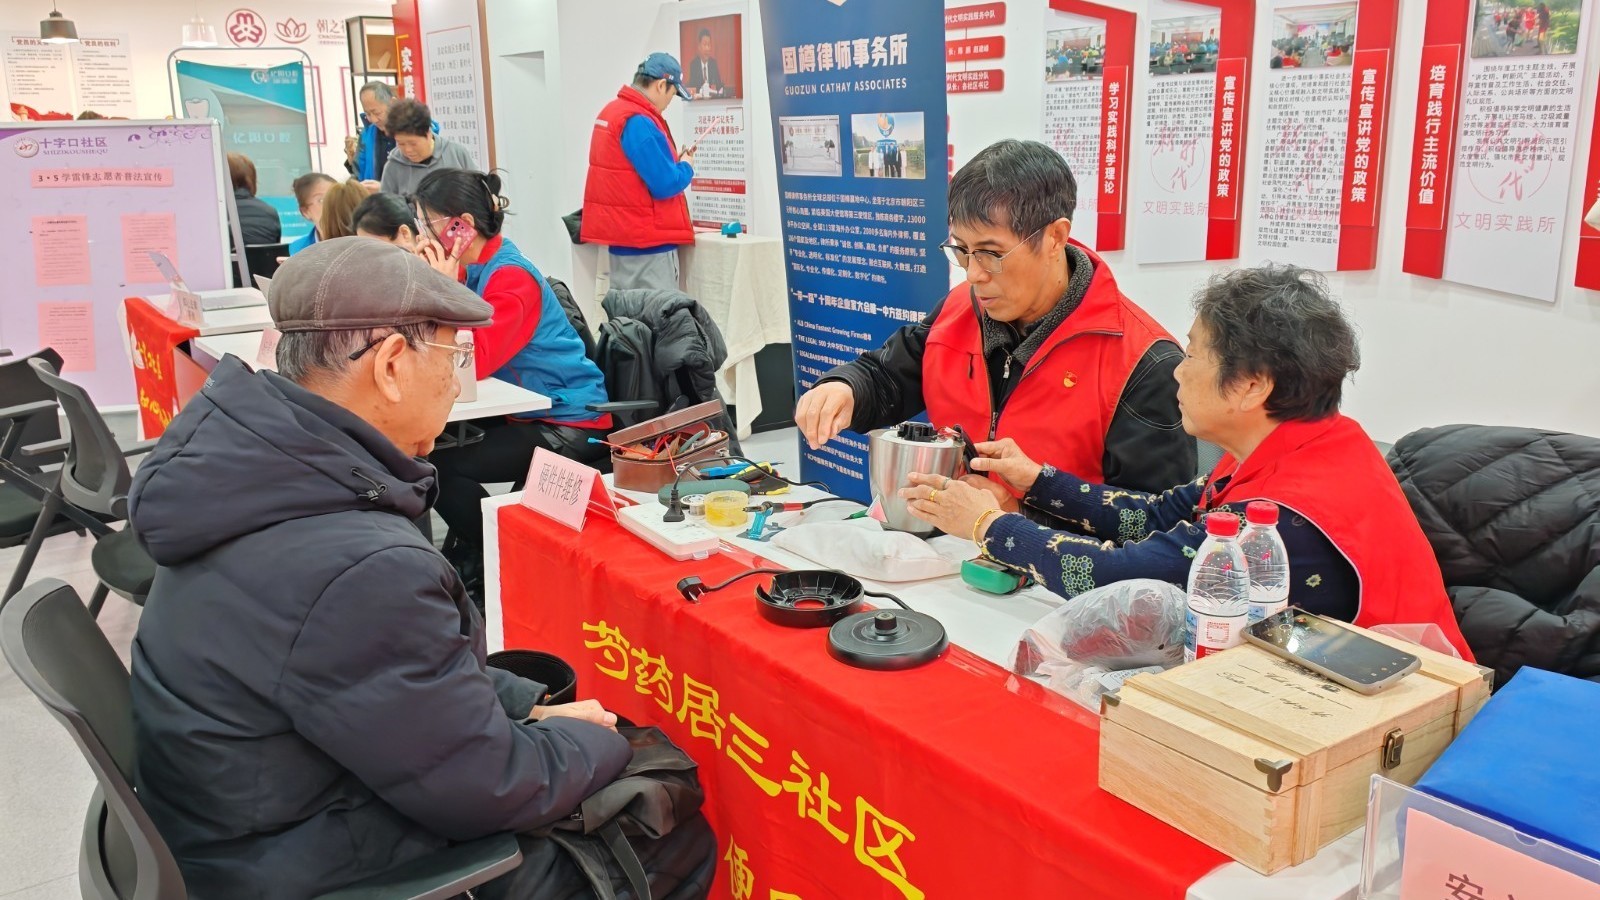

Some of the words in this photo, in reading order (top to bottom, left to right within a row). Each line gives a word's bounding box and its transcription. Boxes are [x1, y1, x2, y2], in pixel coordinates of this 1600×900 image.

[781, 33, 908, 74] 国樽律师事务所
[785, 84, 817, 95] GUOZUN
[820, 82, 851, 93] CATHAY
[854, 78, 907, 91] ASSOCIATES
[39, 137, 108, 148] 十字口社区
[1104, 82, 1120, 195] 学习实践科学理论
[1216, 75, 1237, 198] 宣传宣讲党的政策
[1351, 68, 1377, 203] 宣传宣讲党的政策
[1418, 65, 1447, 205] 培育践行主流价值
[1143, 201, 1209, 216] 文明实践所
[1454, 211, 1557, 234] 文明实践所
[798, 334, 807, 343] THE
[831, 326, 850, 338] Growing
[582, 620, 926, 900] 芍药居三社区
